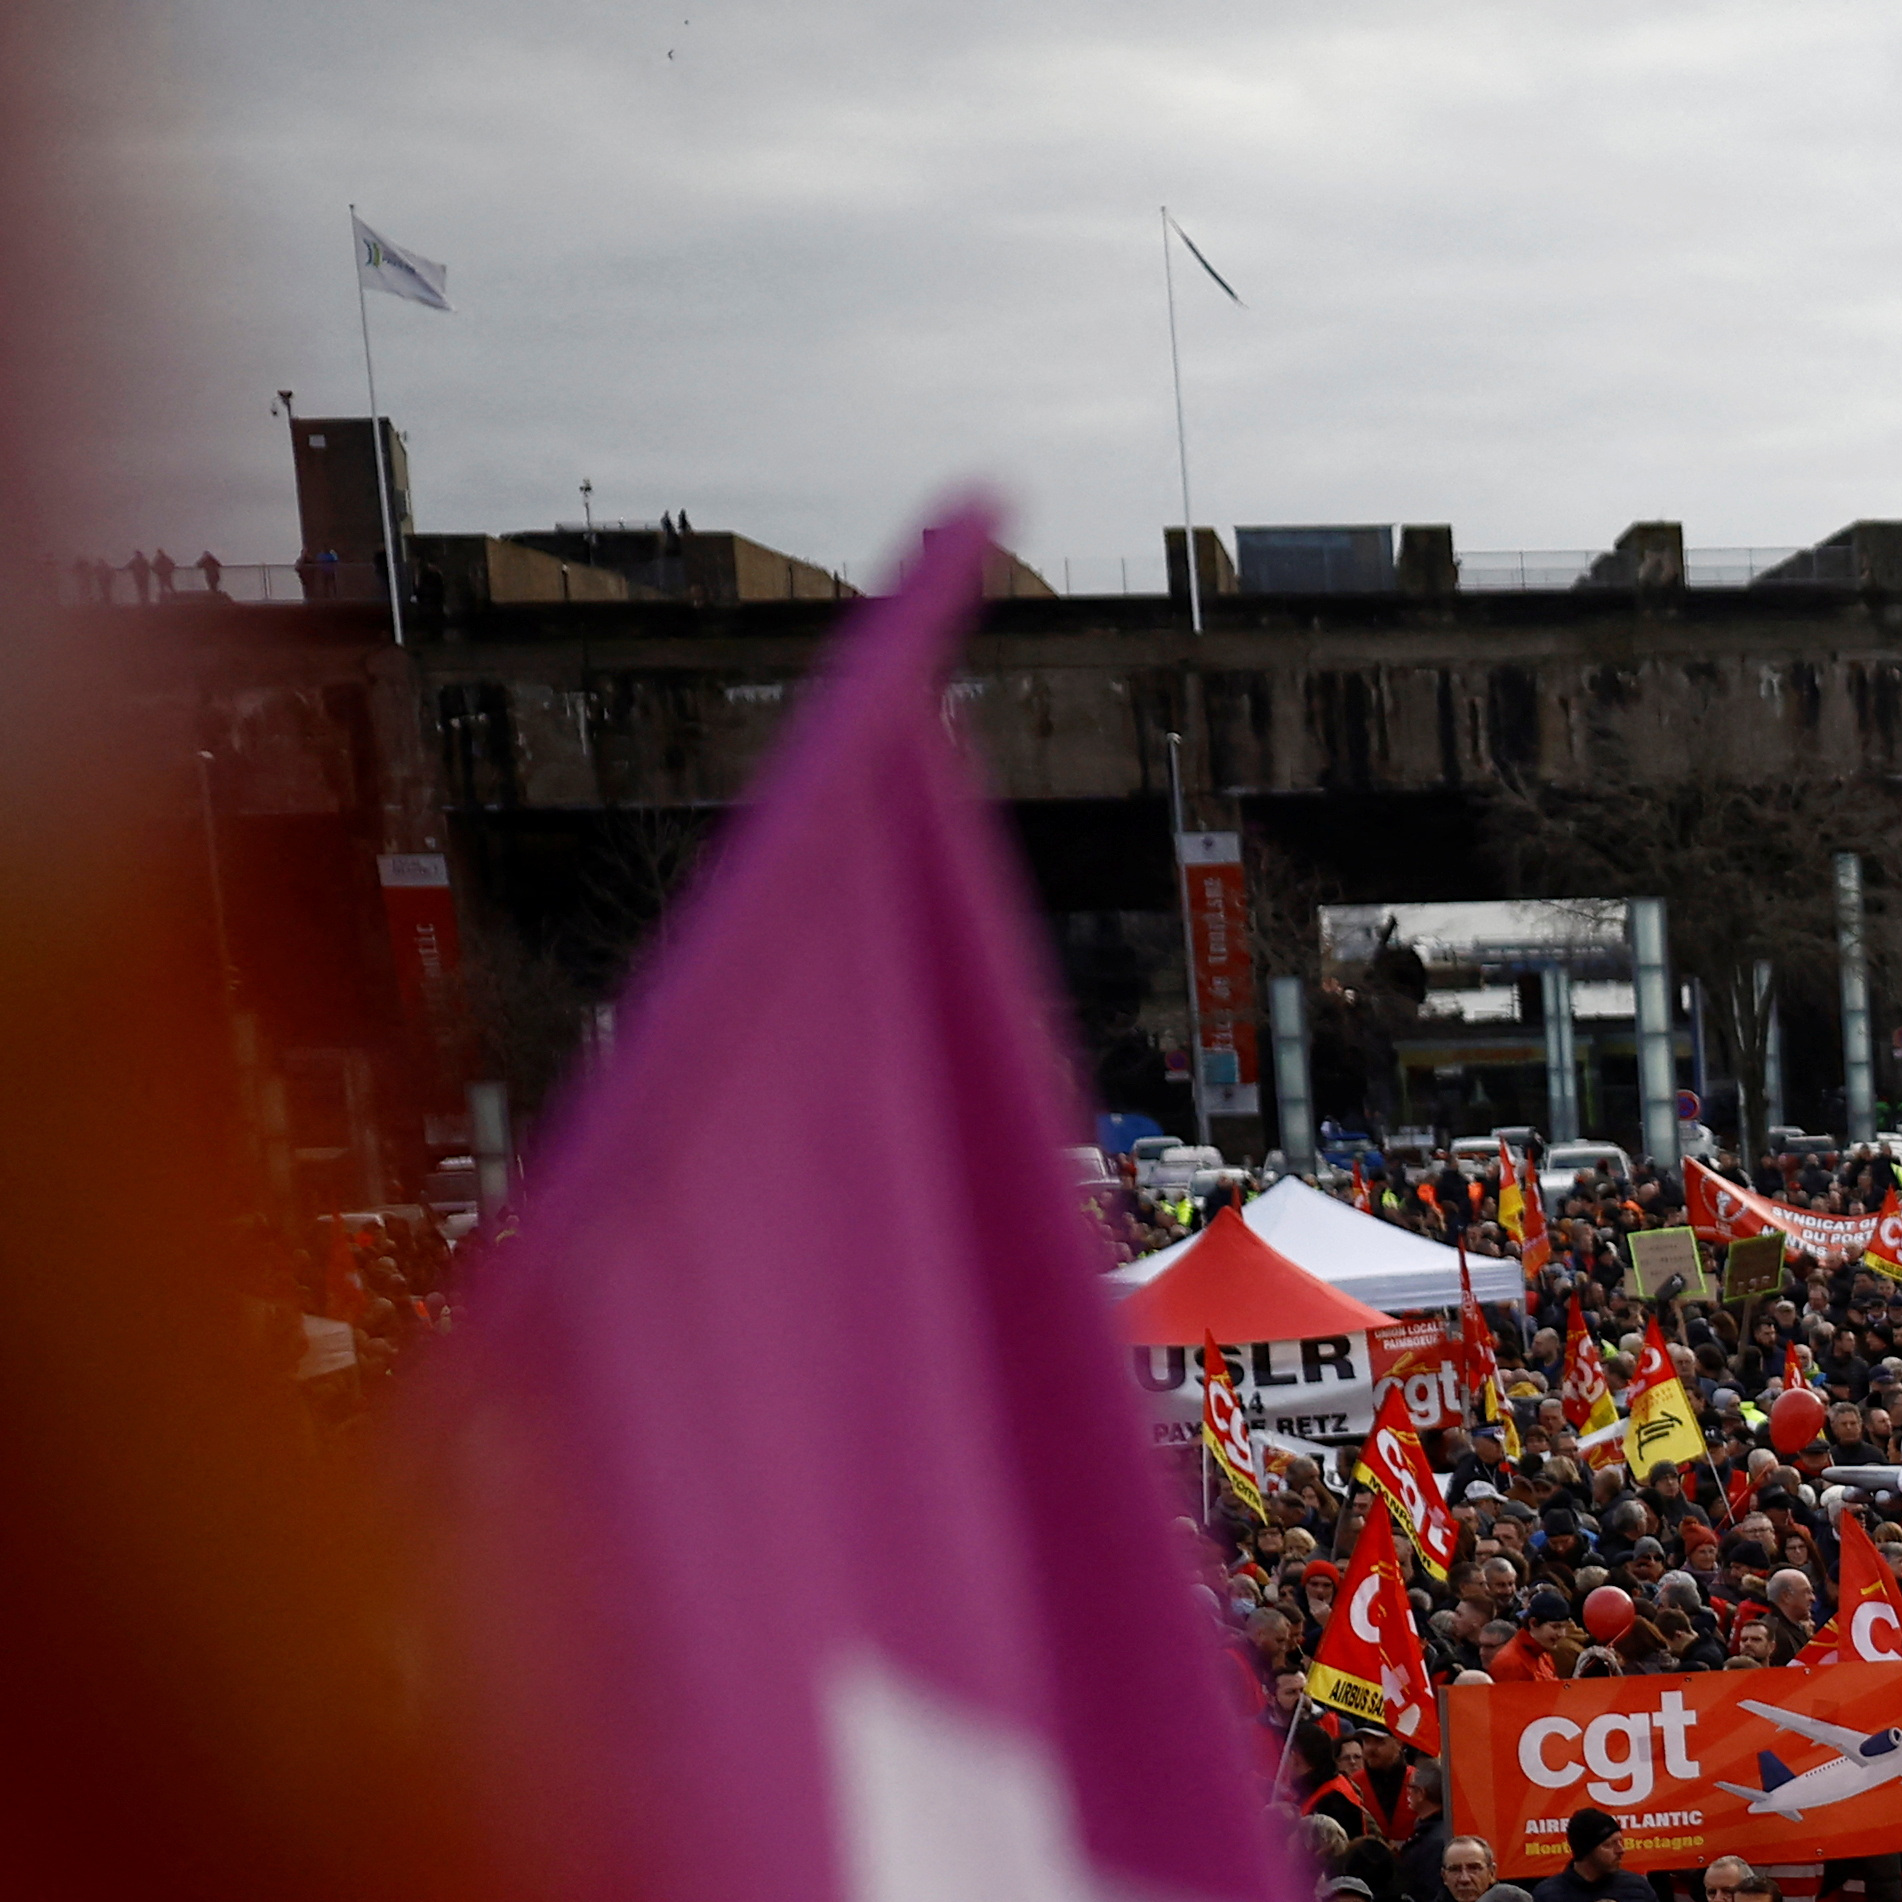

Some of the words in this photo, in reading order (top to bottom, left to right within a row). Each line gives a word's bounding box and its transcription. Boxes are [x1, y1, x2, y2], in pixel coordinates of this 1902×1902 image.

[1771, 1205, 1852, 1231] SYNDICAT
[1802, 1228, 1828, 1242] DU
[1830, 1230, 1874, 1245] PORT
[1373, 1359, 1461, 1428] cgt
[1154, 1421, 1204, 1444] PAY
[1277, 1413, 1349, 1437] RETZ
[1330, 1679, 1369, 1710] AIRBUS
[1518, 1690, 1701, 1806] cgt
[1611, 1810, 1704, 1832] TLANTIC
